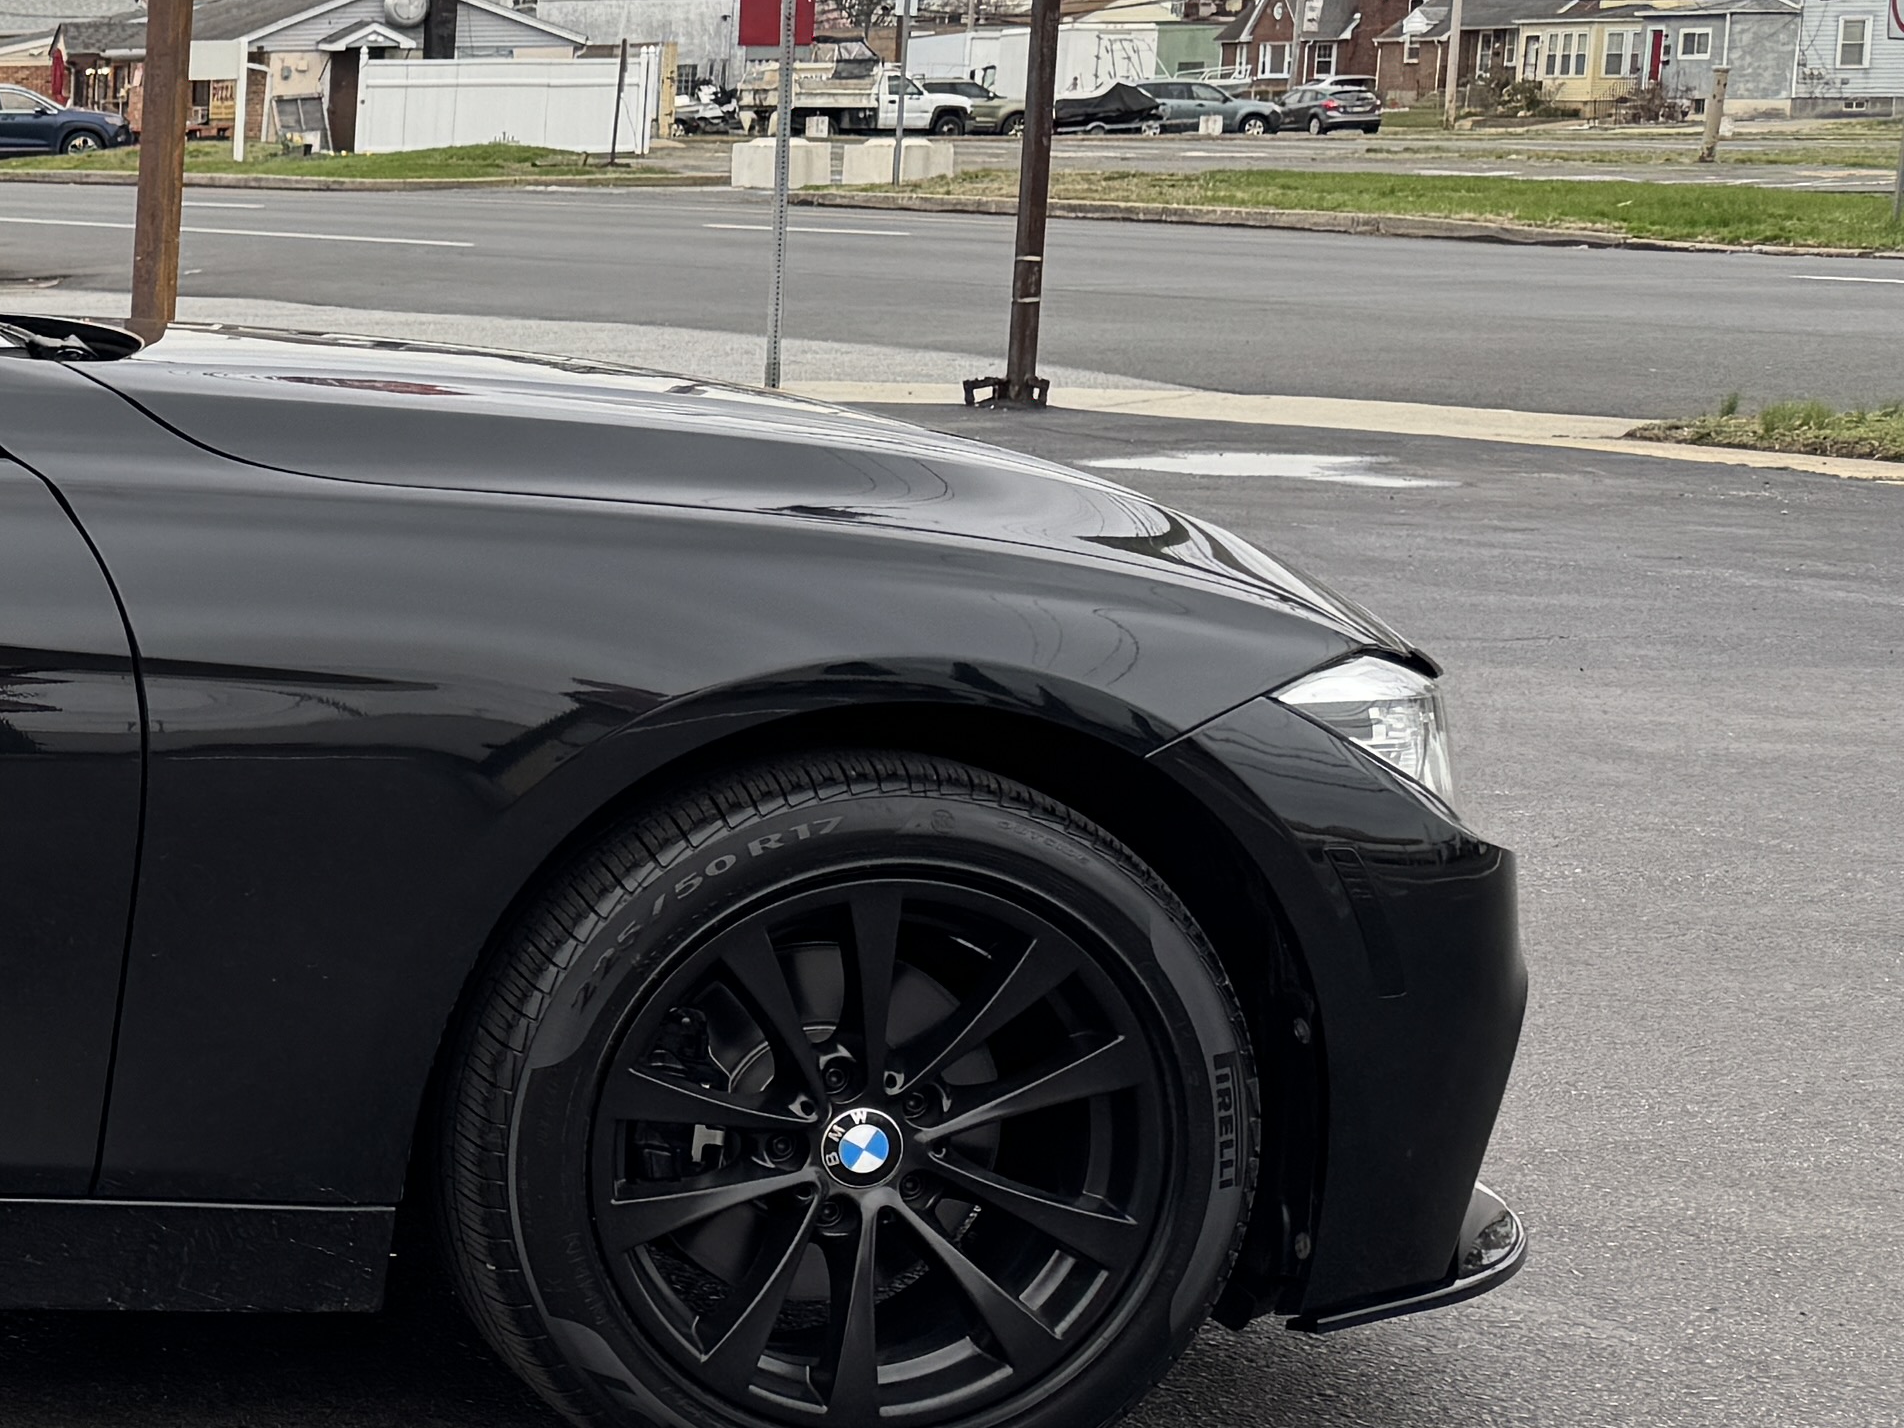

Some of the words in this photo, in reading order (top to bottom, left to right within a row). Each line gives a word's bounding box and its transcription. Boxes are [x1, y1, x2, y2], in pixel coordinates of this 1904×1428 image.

[571, 852, 737, 1015] 225/50
[746, 815, 845, 859] R17
[825, 1109, 868, 1167] BMW
[1213, 1050, 1239, 1190] PIRELLI
